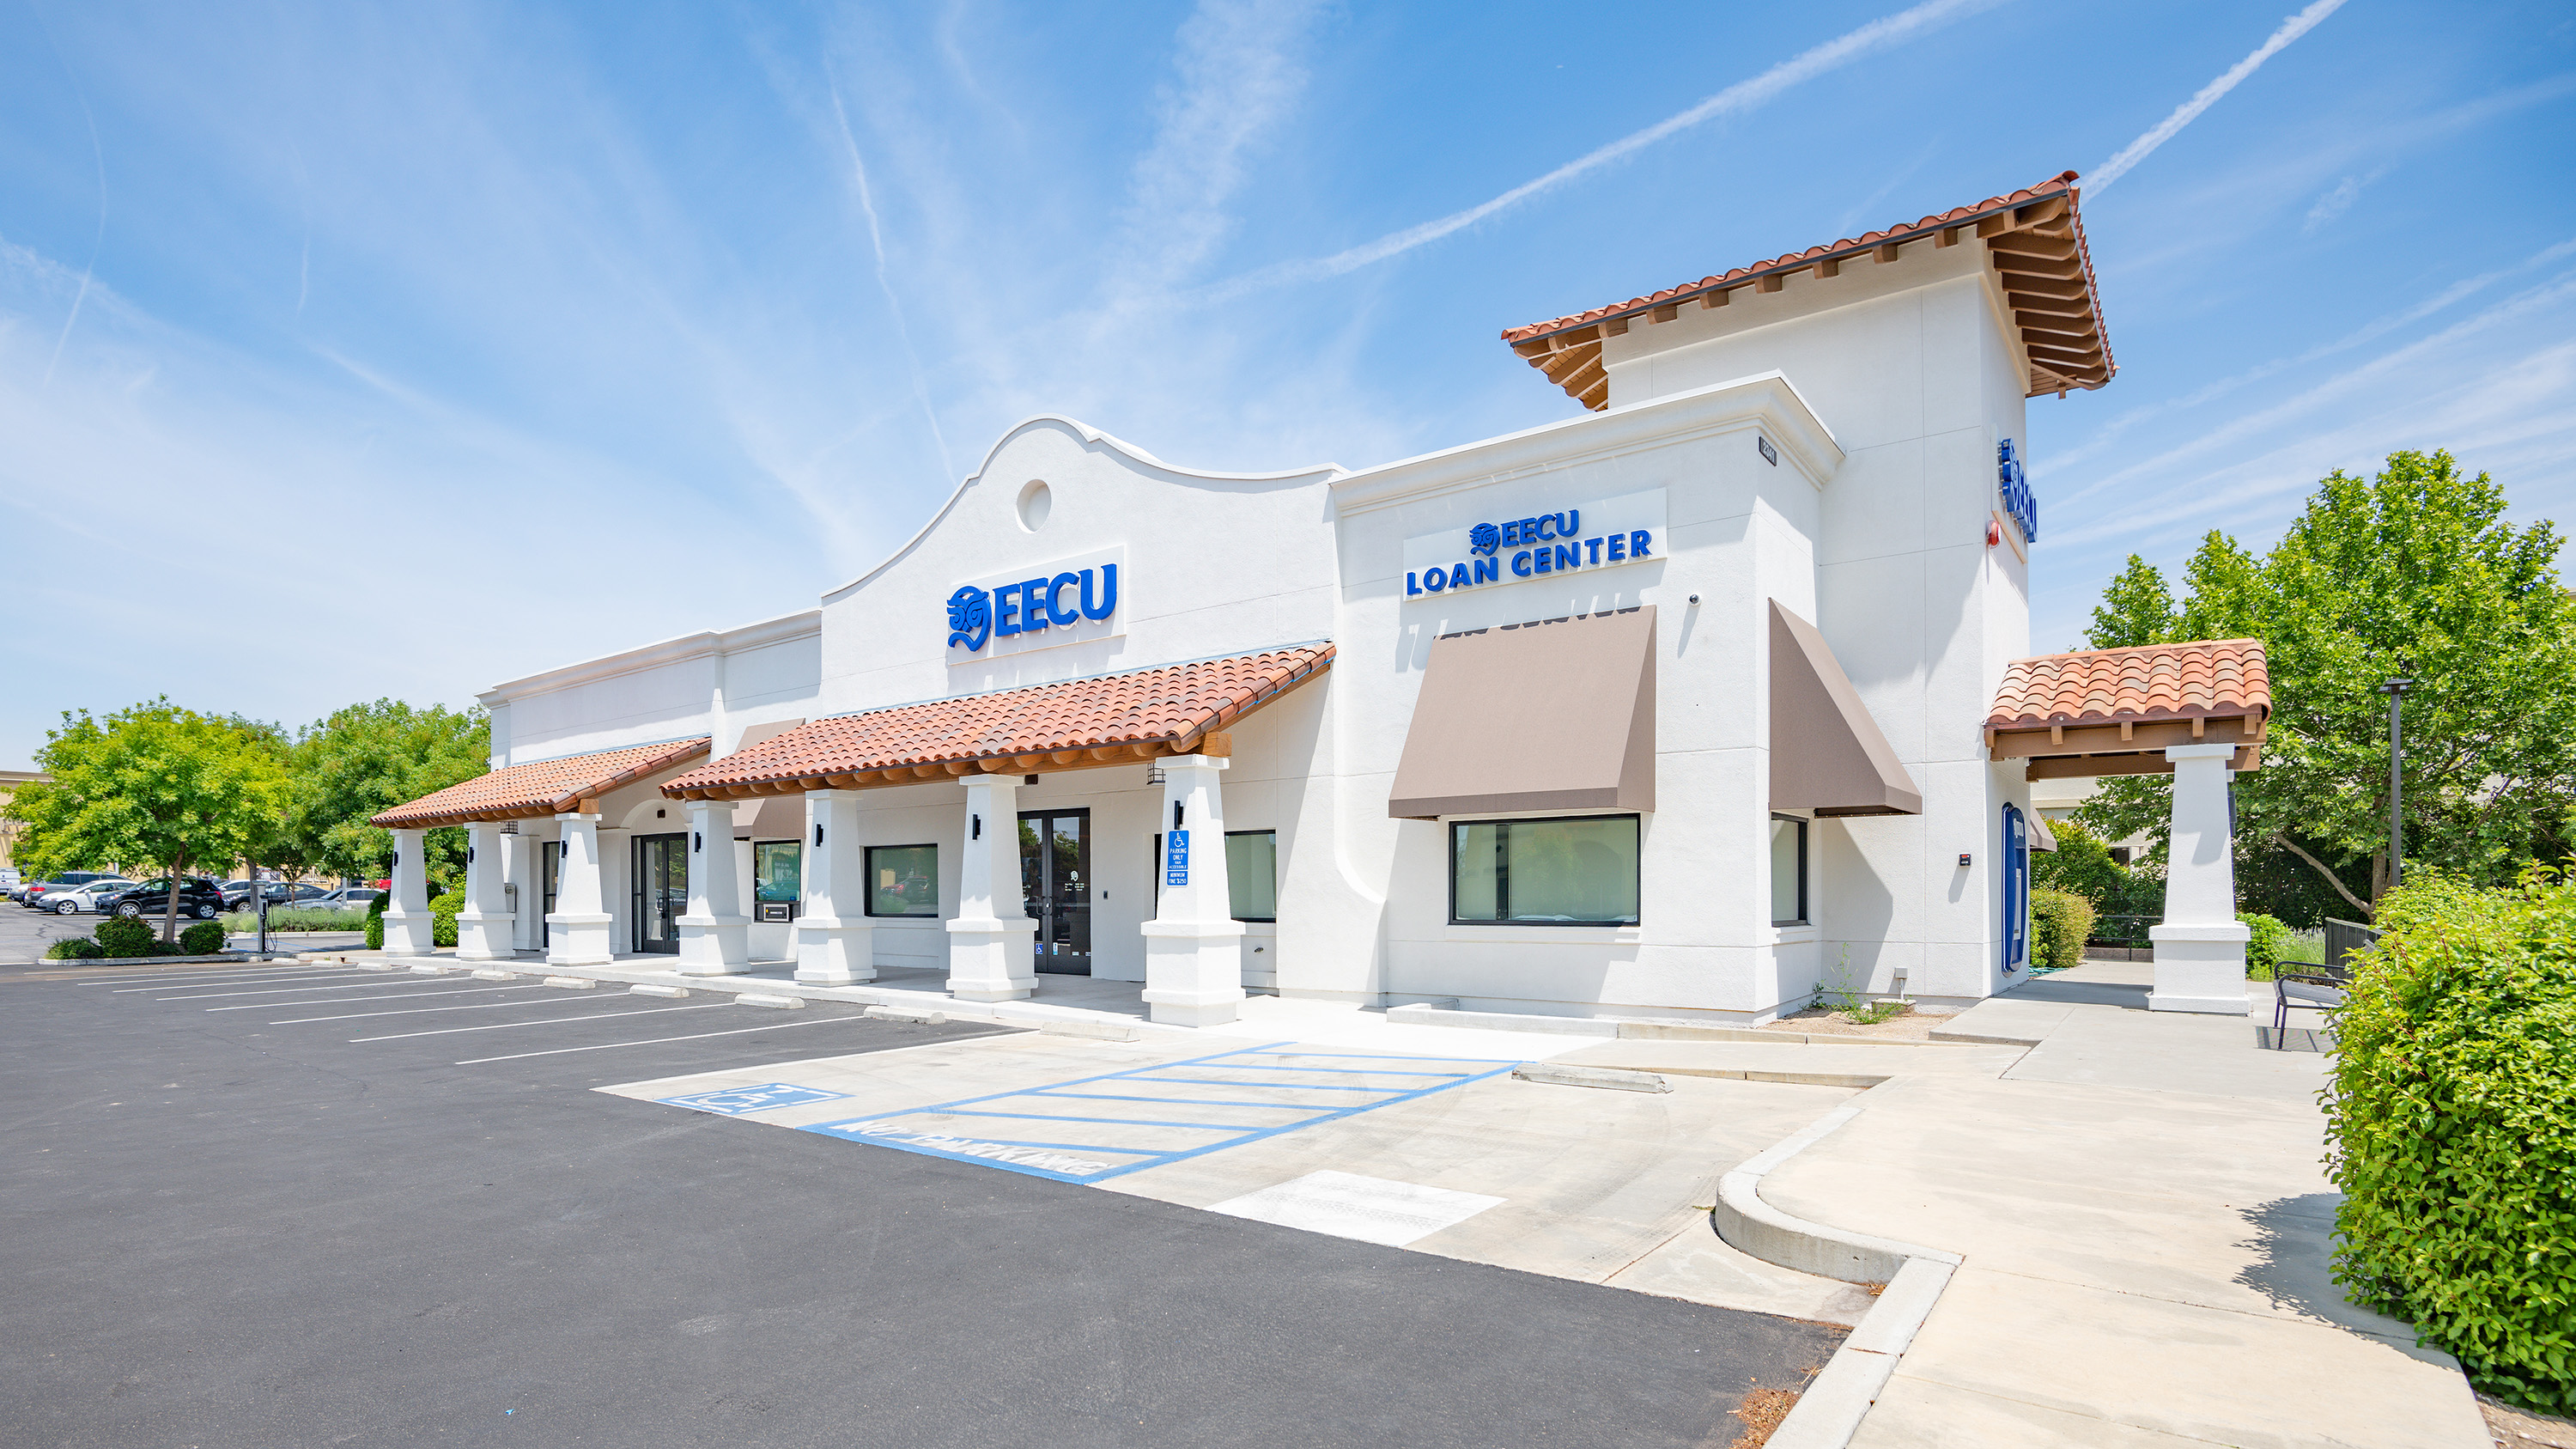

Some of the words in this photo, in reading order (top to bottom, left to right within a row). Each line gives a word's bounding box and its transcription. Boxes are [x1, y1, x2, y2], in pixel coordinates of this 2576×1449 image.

[1500, 509, 1580, 549] EECU
[1406, 557, 1499, 596] LOAN
[1511, 529, 1654, 577] CENTER
[992, 563, 1117, 637] EECU
[827, 1120, 913, 1137] NO
[903, 1133, 1116, 1176] PARKING
